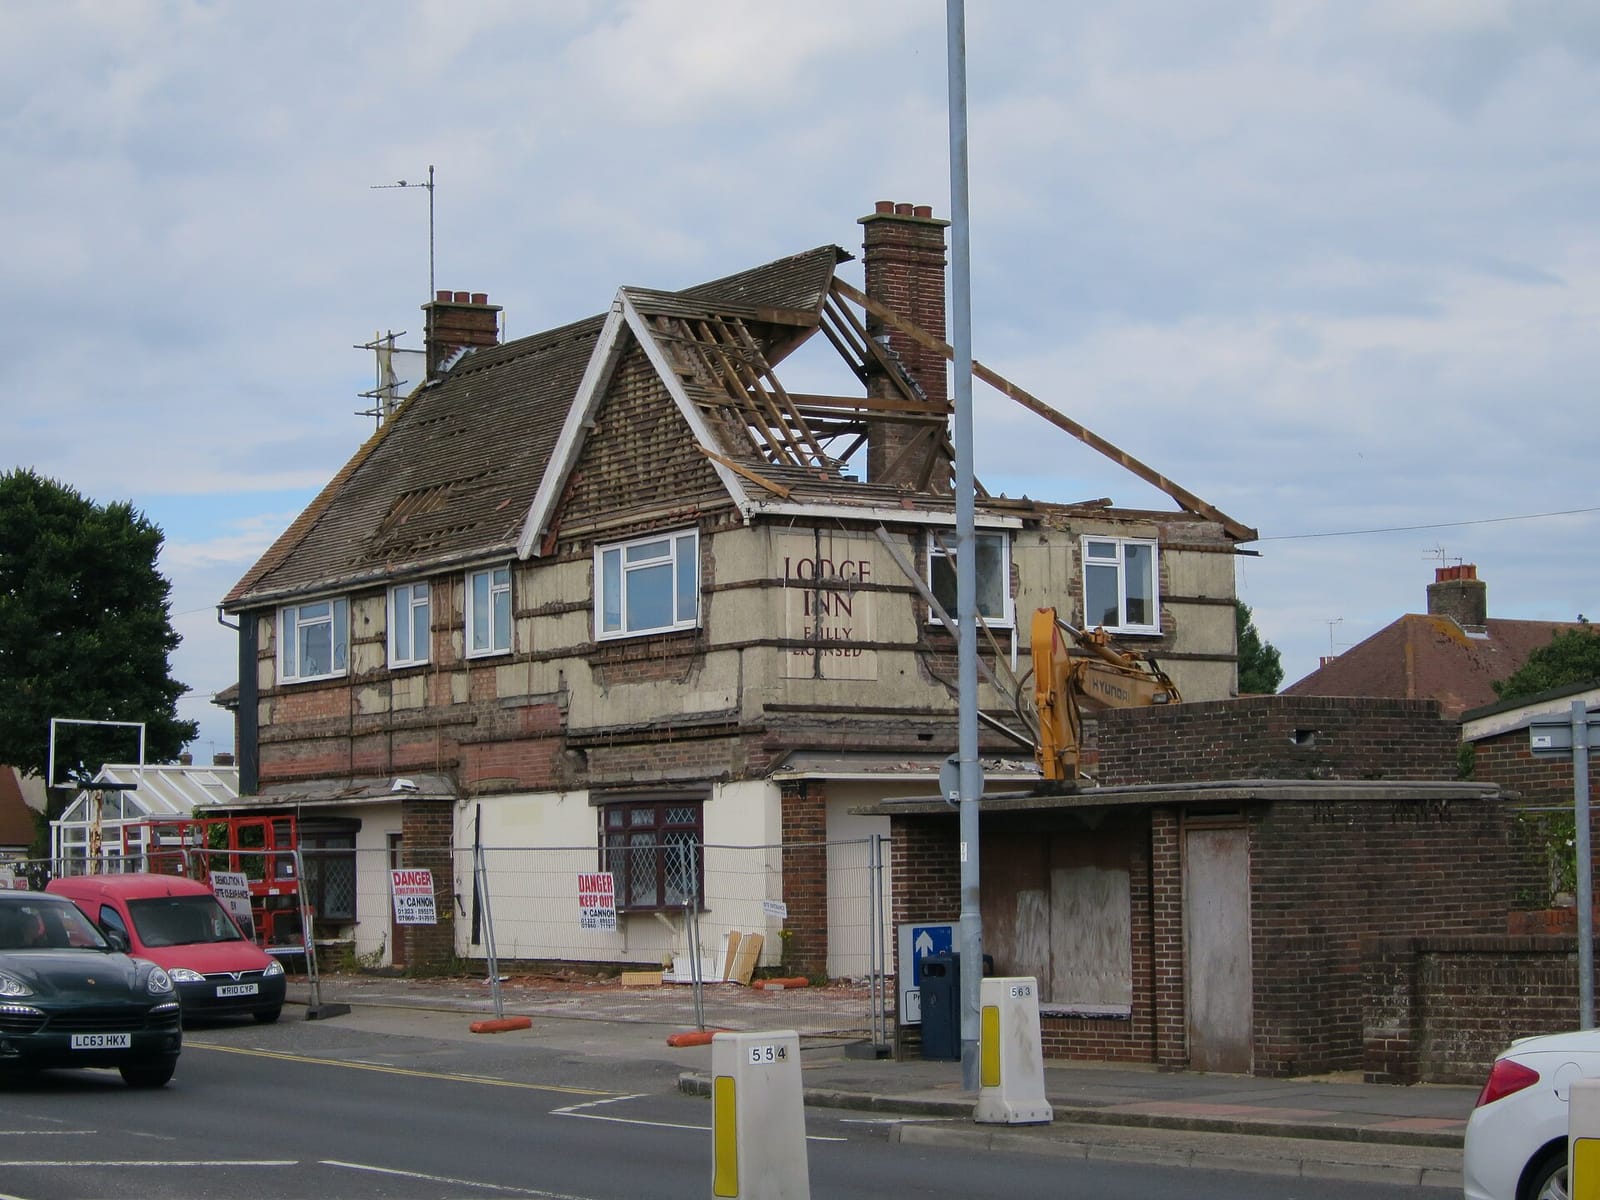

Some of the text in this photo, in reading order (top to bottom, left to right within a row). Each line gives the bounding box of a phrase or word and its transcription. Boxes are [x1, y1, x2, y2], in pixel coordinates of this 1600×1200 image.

[803, 590, 852, 617] INN
[393, 871, 432, 886] DANGER
[578, 874, 613, 893] DANGER
[406, 897, 434, 908] CANNON
[579, 895, 613, 908] KEEP OUT
[590, 909, 615, 918] CANNON
[1011, 986, 1031, 997] 563
[75, 1034, 126, 1047] LC63 HKX
[752, 1047, 786, 1061] 554
